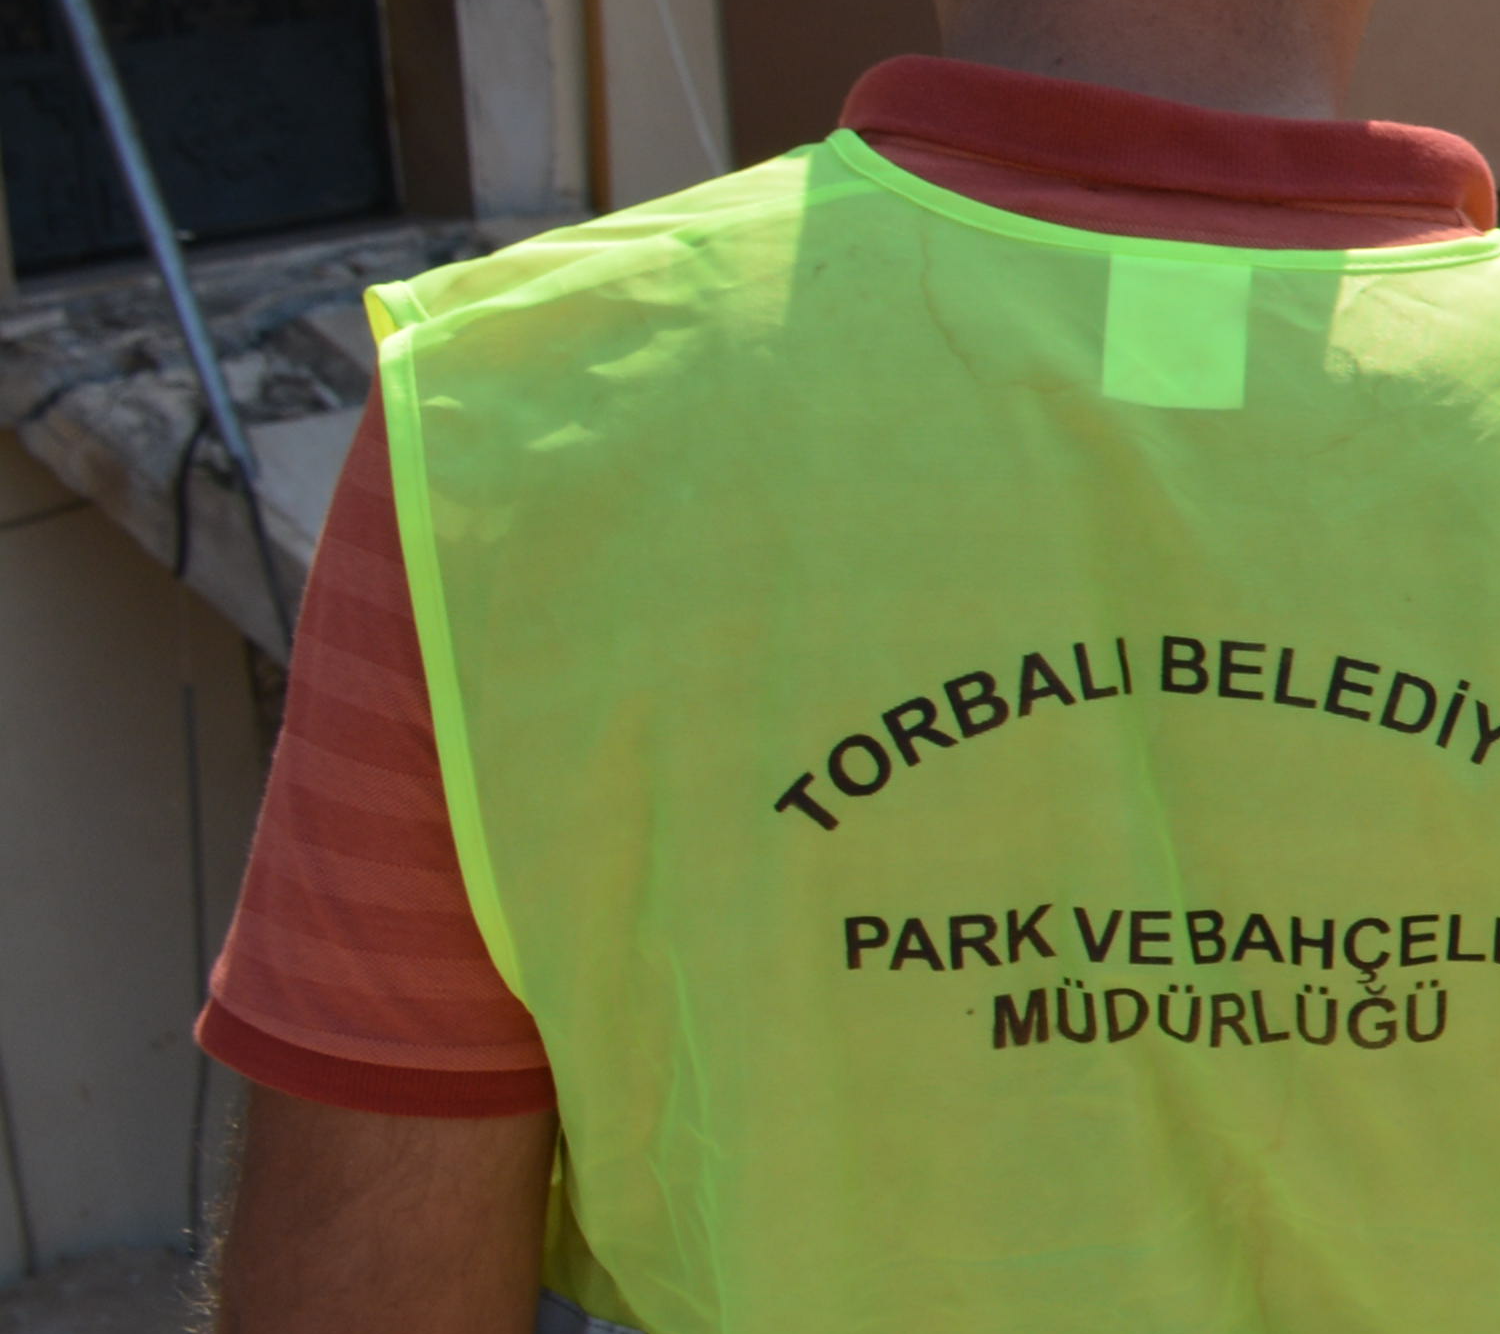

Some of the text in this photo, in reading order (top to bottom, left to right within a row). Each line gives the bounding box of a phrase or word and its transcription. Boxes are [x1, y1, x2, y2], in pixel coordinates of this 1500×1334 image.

[774, 636, 1132, 832] TORBALI
[844, 903, 1056, 972] PARK
[991, 976, 1449, 1050] MÜDÜRLÜĞÜ
